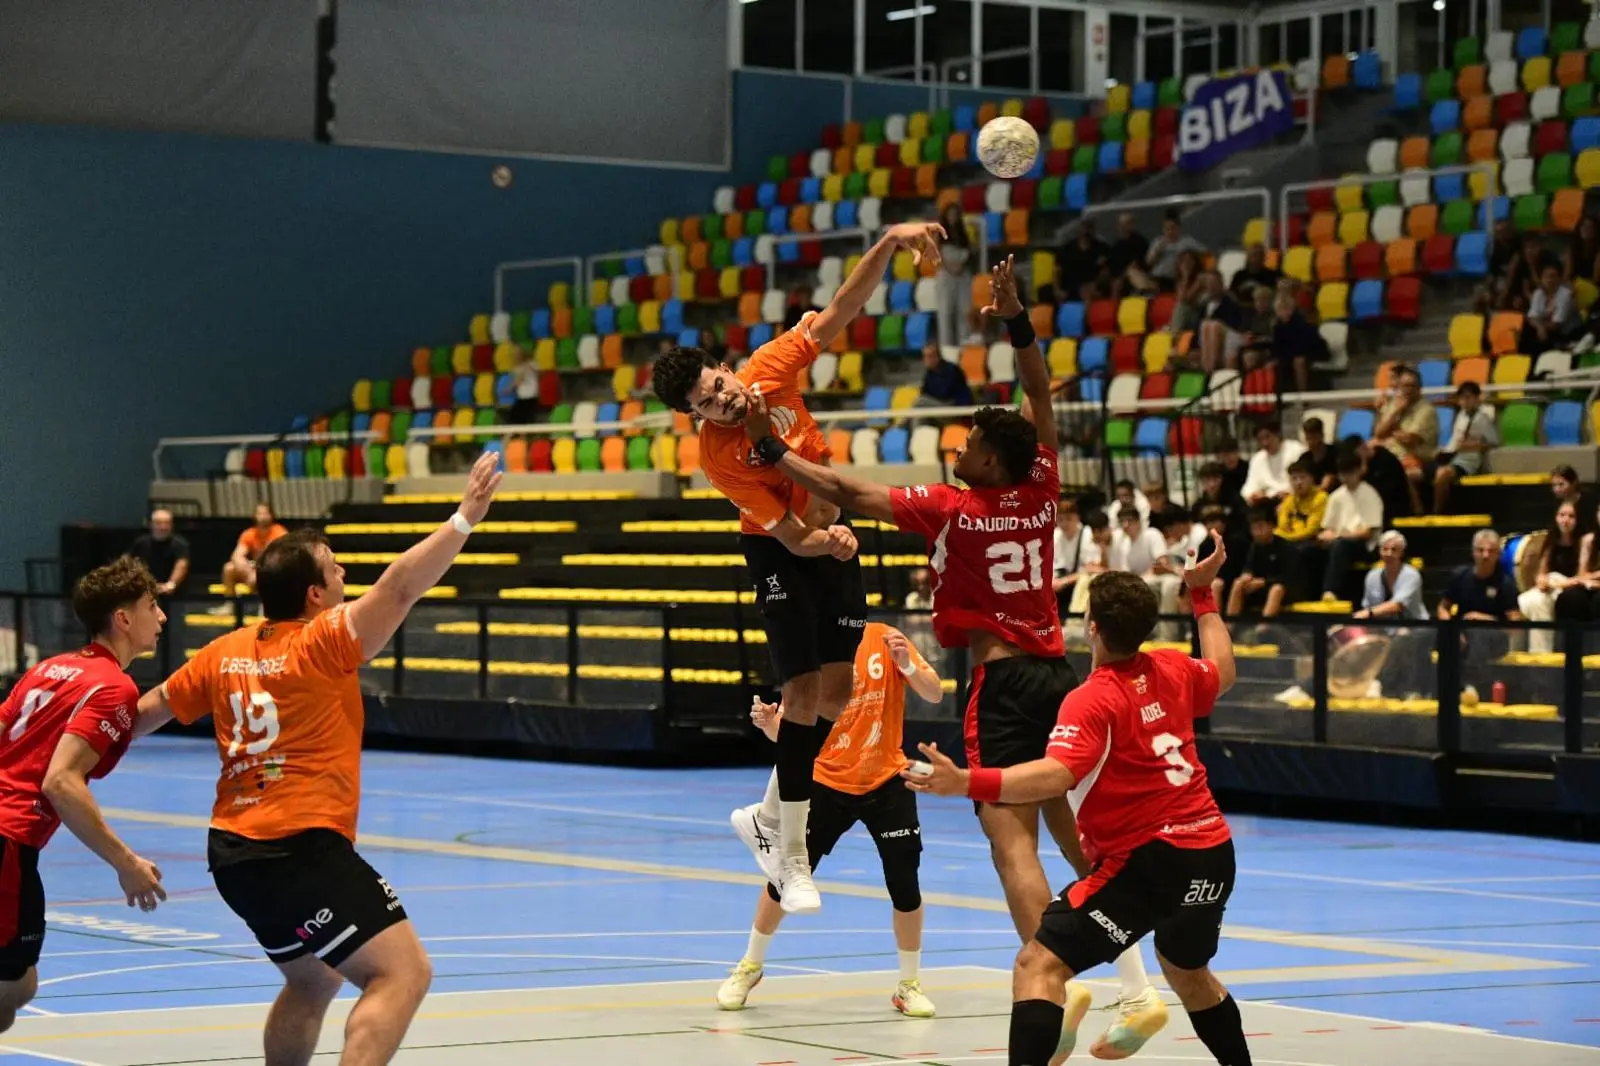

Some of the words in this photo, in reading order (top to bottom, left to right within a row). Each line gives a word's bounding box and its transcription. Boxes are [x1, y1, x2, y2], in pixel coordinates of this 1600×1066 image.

[1172, 69, 1285, 162] BIZA
[958, 512, 1019, 533] CLAUDIO
[985, 538, 1043, 594] 21
[867, 652, 885, 680] 6
[228, 690, 281, 758] 19
[1140, 701, 1167, 724] ADEL
[1152, 732, 1195, 787] 3
[1183, 879, 1224, 902] atu
